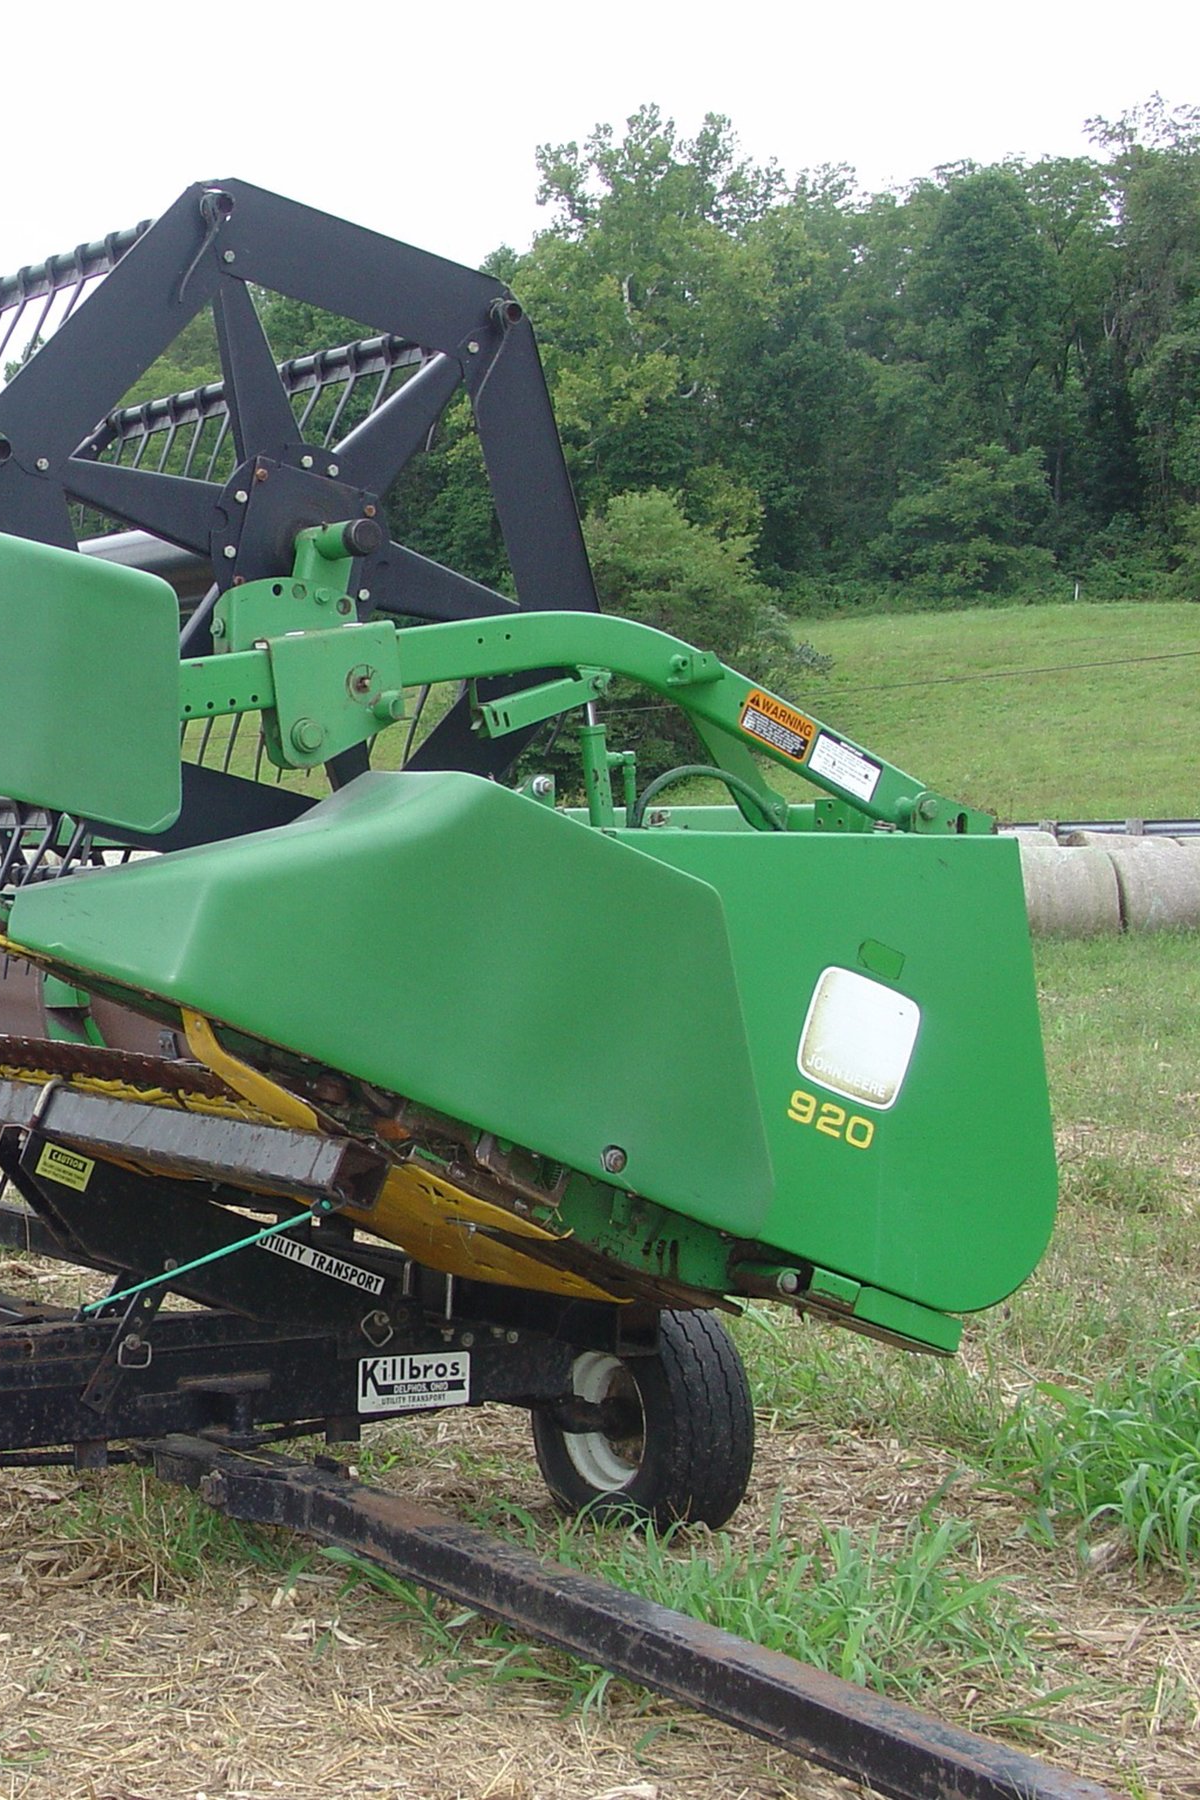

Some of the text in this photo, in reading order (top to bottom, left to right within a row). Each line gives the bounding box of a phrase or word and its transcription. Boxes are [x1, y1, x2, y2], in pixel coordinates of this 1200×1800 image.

[761, 698, 813, 737] WARNING
[807, 1054, 886, 1097] JOHN DEERE
[787, 1090, 875, 1150] 920
[52, 1152, 84, 1170] CAUTION
[260, 1236, 382, 1292] UTILITY TRANSPORT
[361, 1357, 460, 1398] Killbros
[430, 1381, 448, 1391] OHIO
[381, 1393, 446, 1405] UTILITY TRANSPORT
